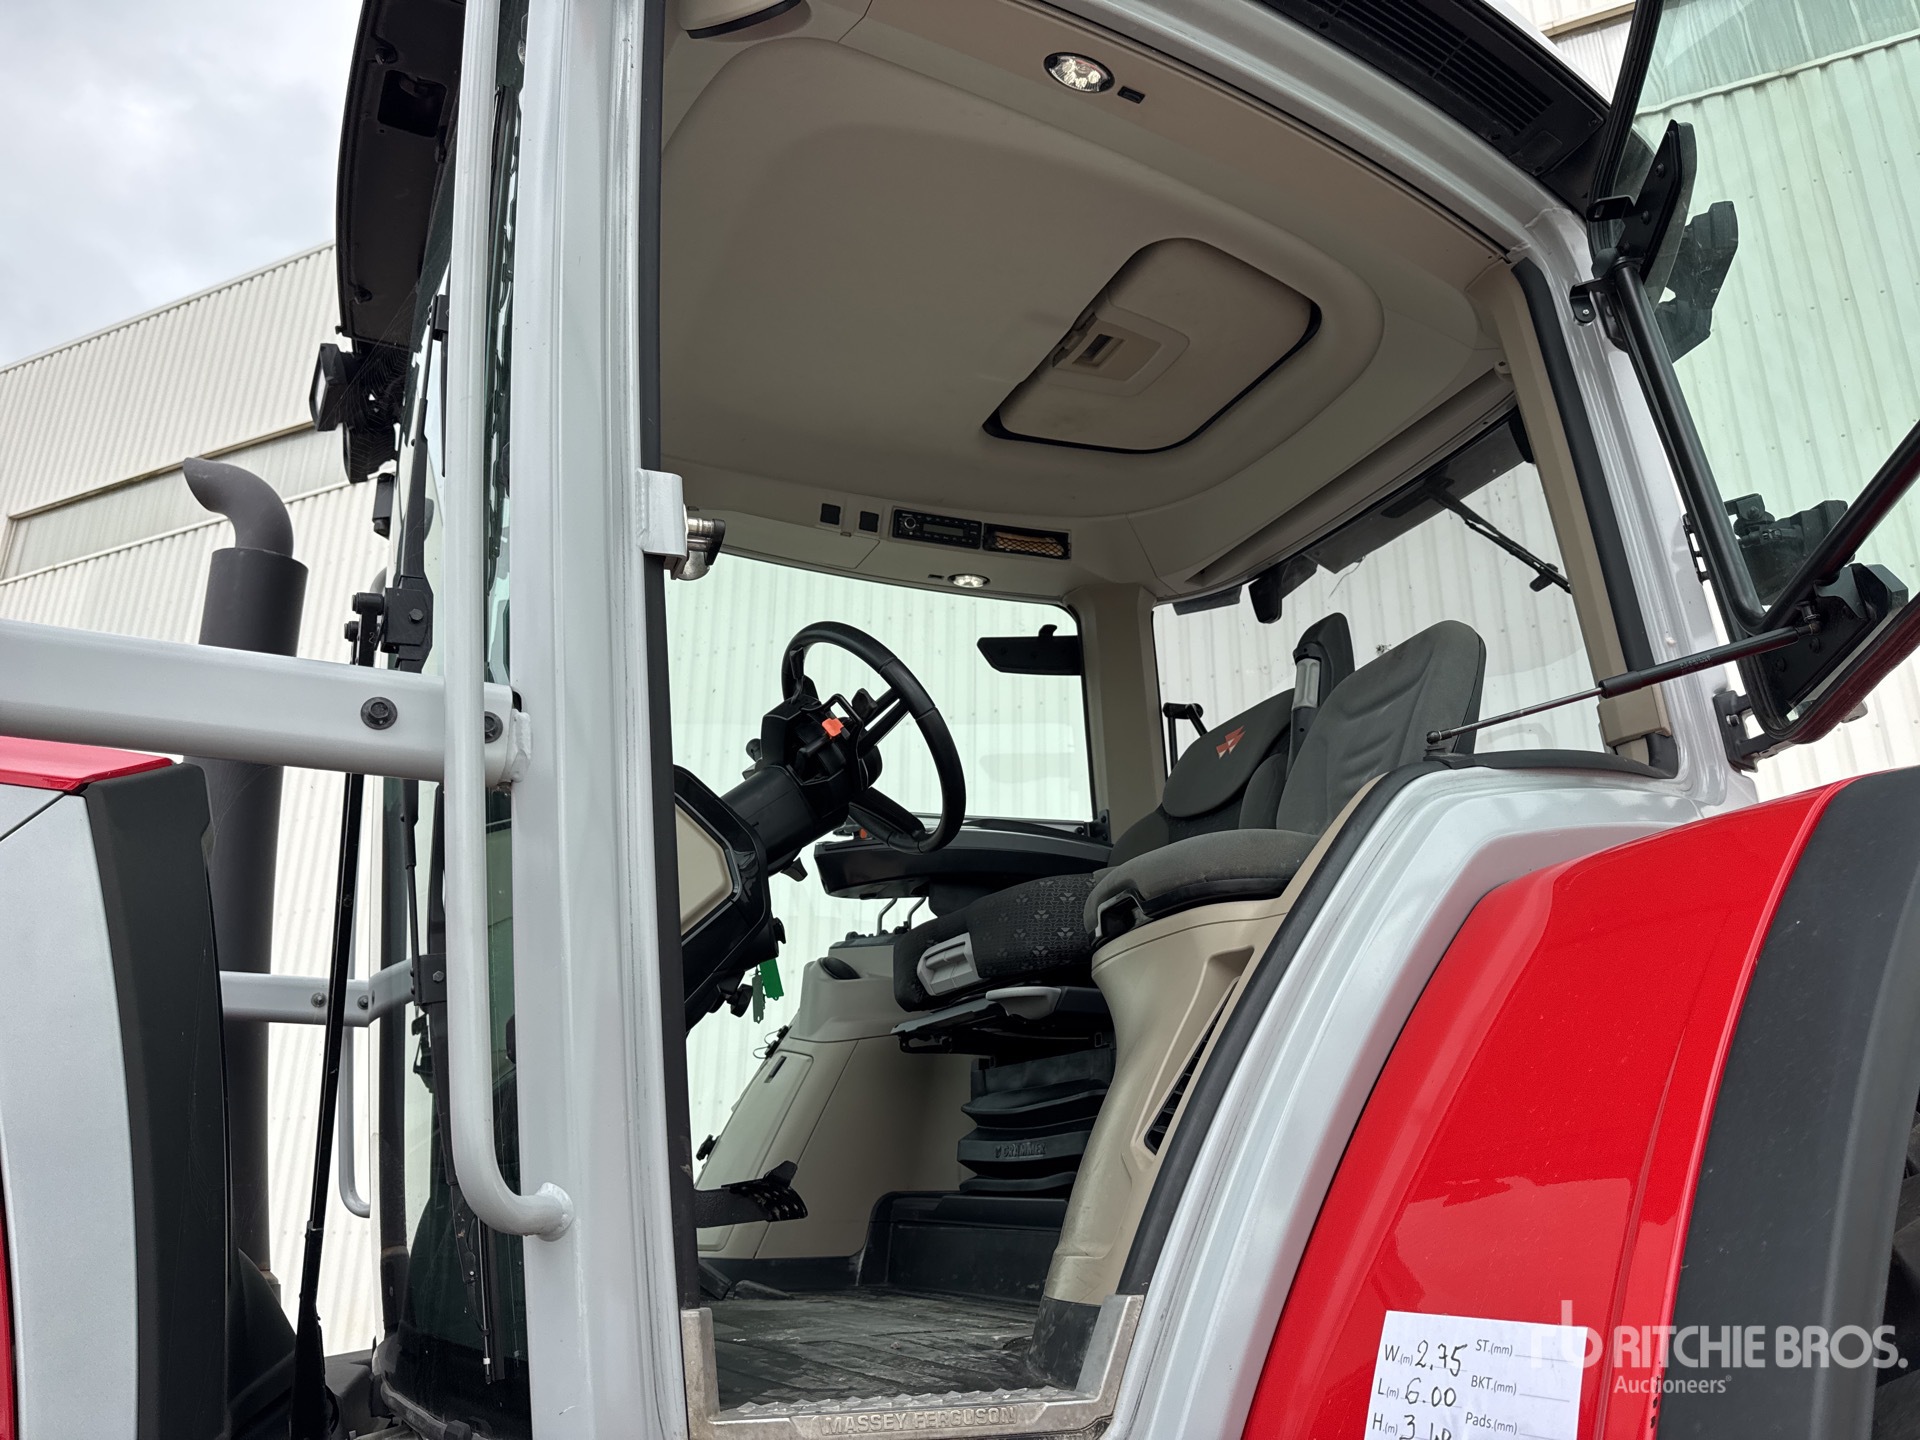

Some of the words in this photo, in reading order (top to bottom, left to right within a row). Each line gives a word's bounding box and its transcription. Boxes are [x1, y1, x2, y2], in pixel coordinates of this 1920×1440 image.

[1415, 1340, 1468, 1377] 2.75
[1405, 1377, 1457, 1407] 6.00
[822, 1412, 908, 1436] MASSEY
[913, 1406, 1018, 1430] FERGUSON
